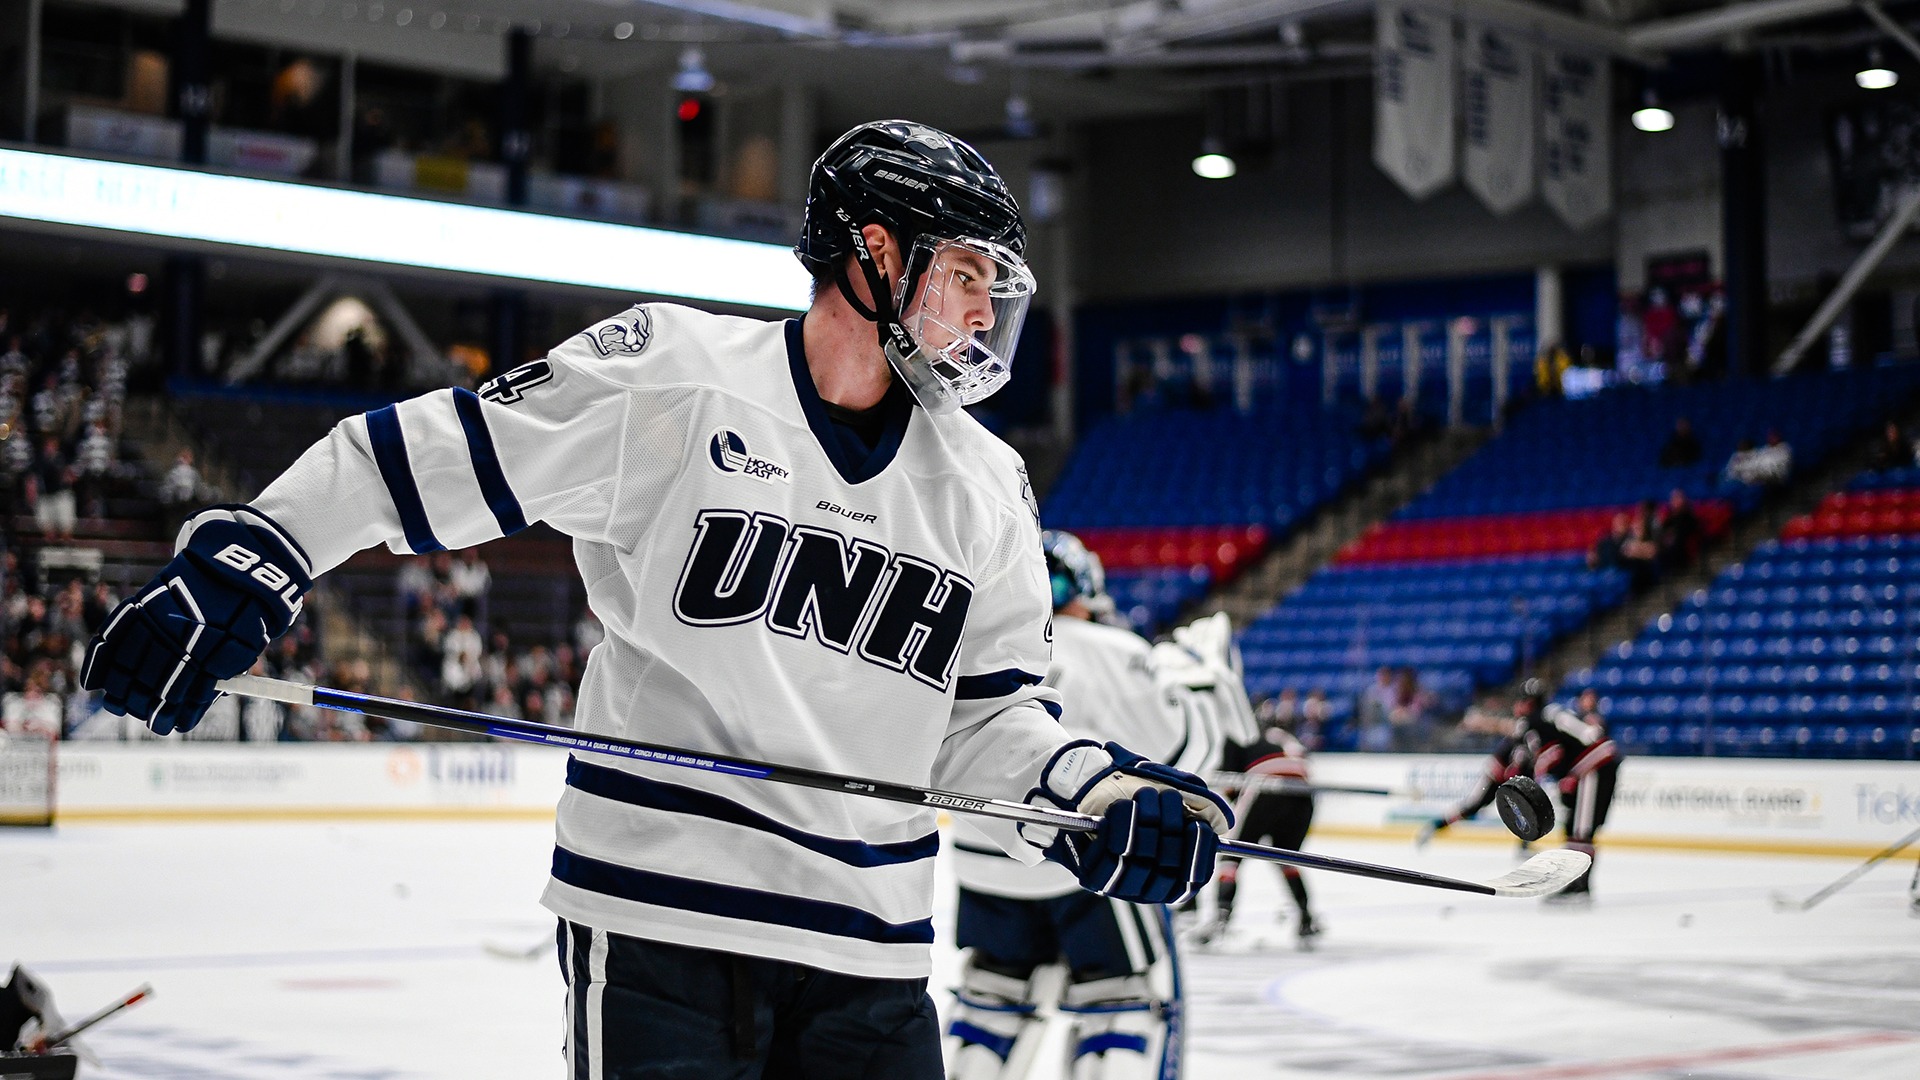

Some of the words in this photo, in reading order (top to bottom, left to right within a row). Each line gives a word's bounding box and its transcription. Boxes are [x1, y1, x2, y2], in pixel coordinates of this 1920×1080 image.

[743, 465, 773, 480] EAST
[747, 457, 789, 479] HOCKEY
[672, 508, 975, 694] UNH
[577, 739, 588, 747] FOR
[593, 742, 609, 750] QUICK
[609, 744, 632, 754] RELEASE
[676, 755, 696, 764] LANCER
